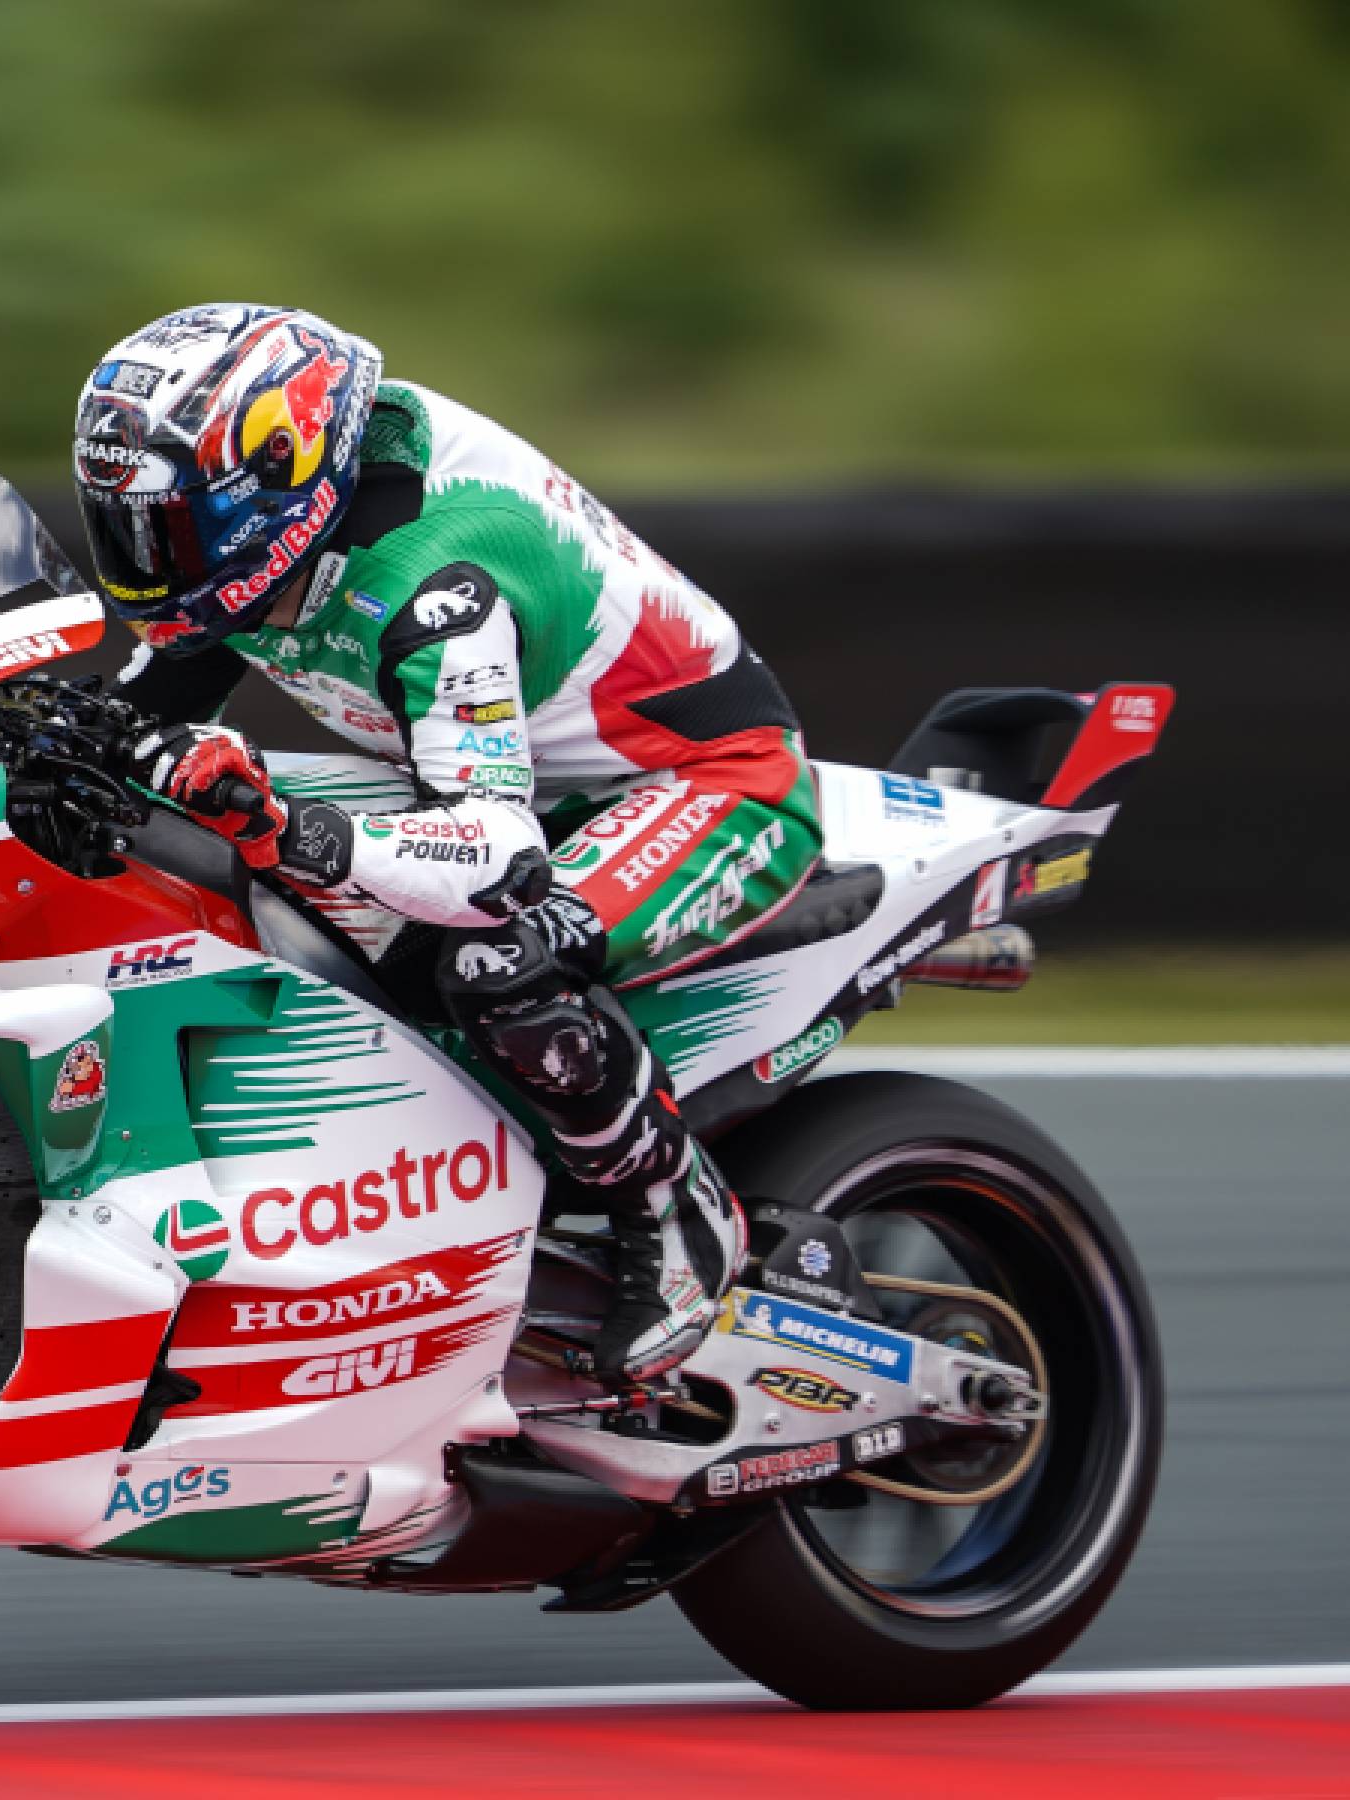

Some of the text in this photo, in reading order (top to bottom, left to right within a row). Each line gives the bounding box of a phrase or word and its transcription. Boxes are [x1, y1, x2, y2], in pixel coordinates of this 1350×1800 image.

[217, 541, 291, 613] Red
[281, 477, 339, 557] Bull
[612, 792, 730, 891] HONDA
[107, 937, 200, 979] HRC
[770, 1021, 835, 1074] DRACO
[240, 1119, 509, 1260] Castrol
[230, 1270, 451, 1333] HONDA
[281, 1336, 415, 1397] GIVI
[780, 1316, 900, 1368] MICHELIN
[745, 1366, 861, 1412] PBR
